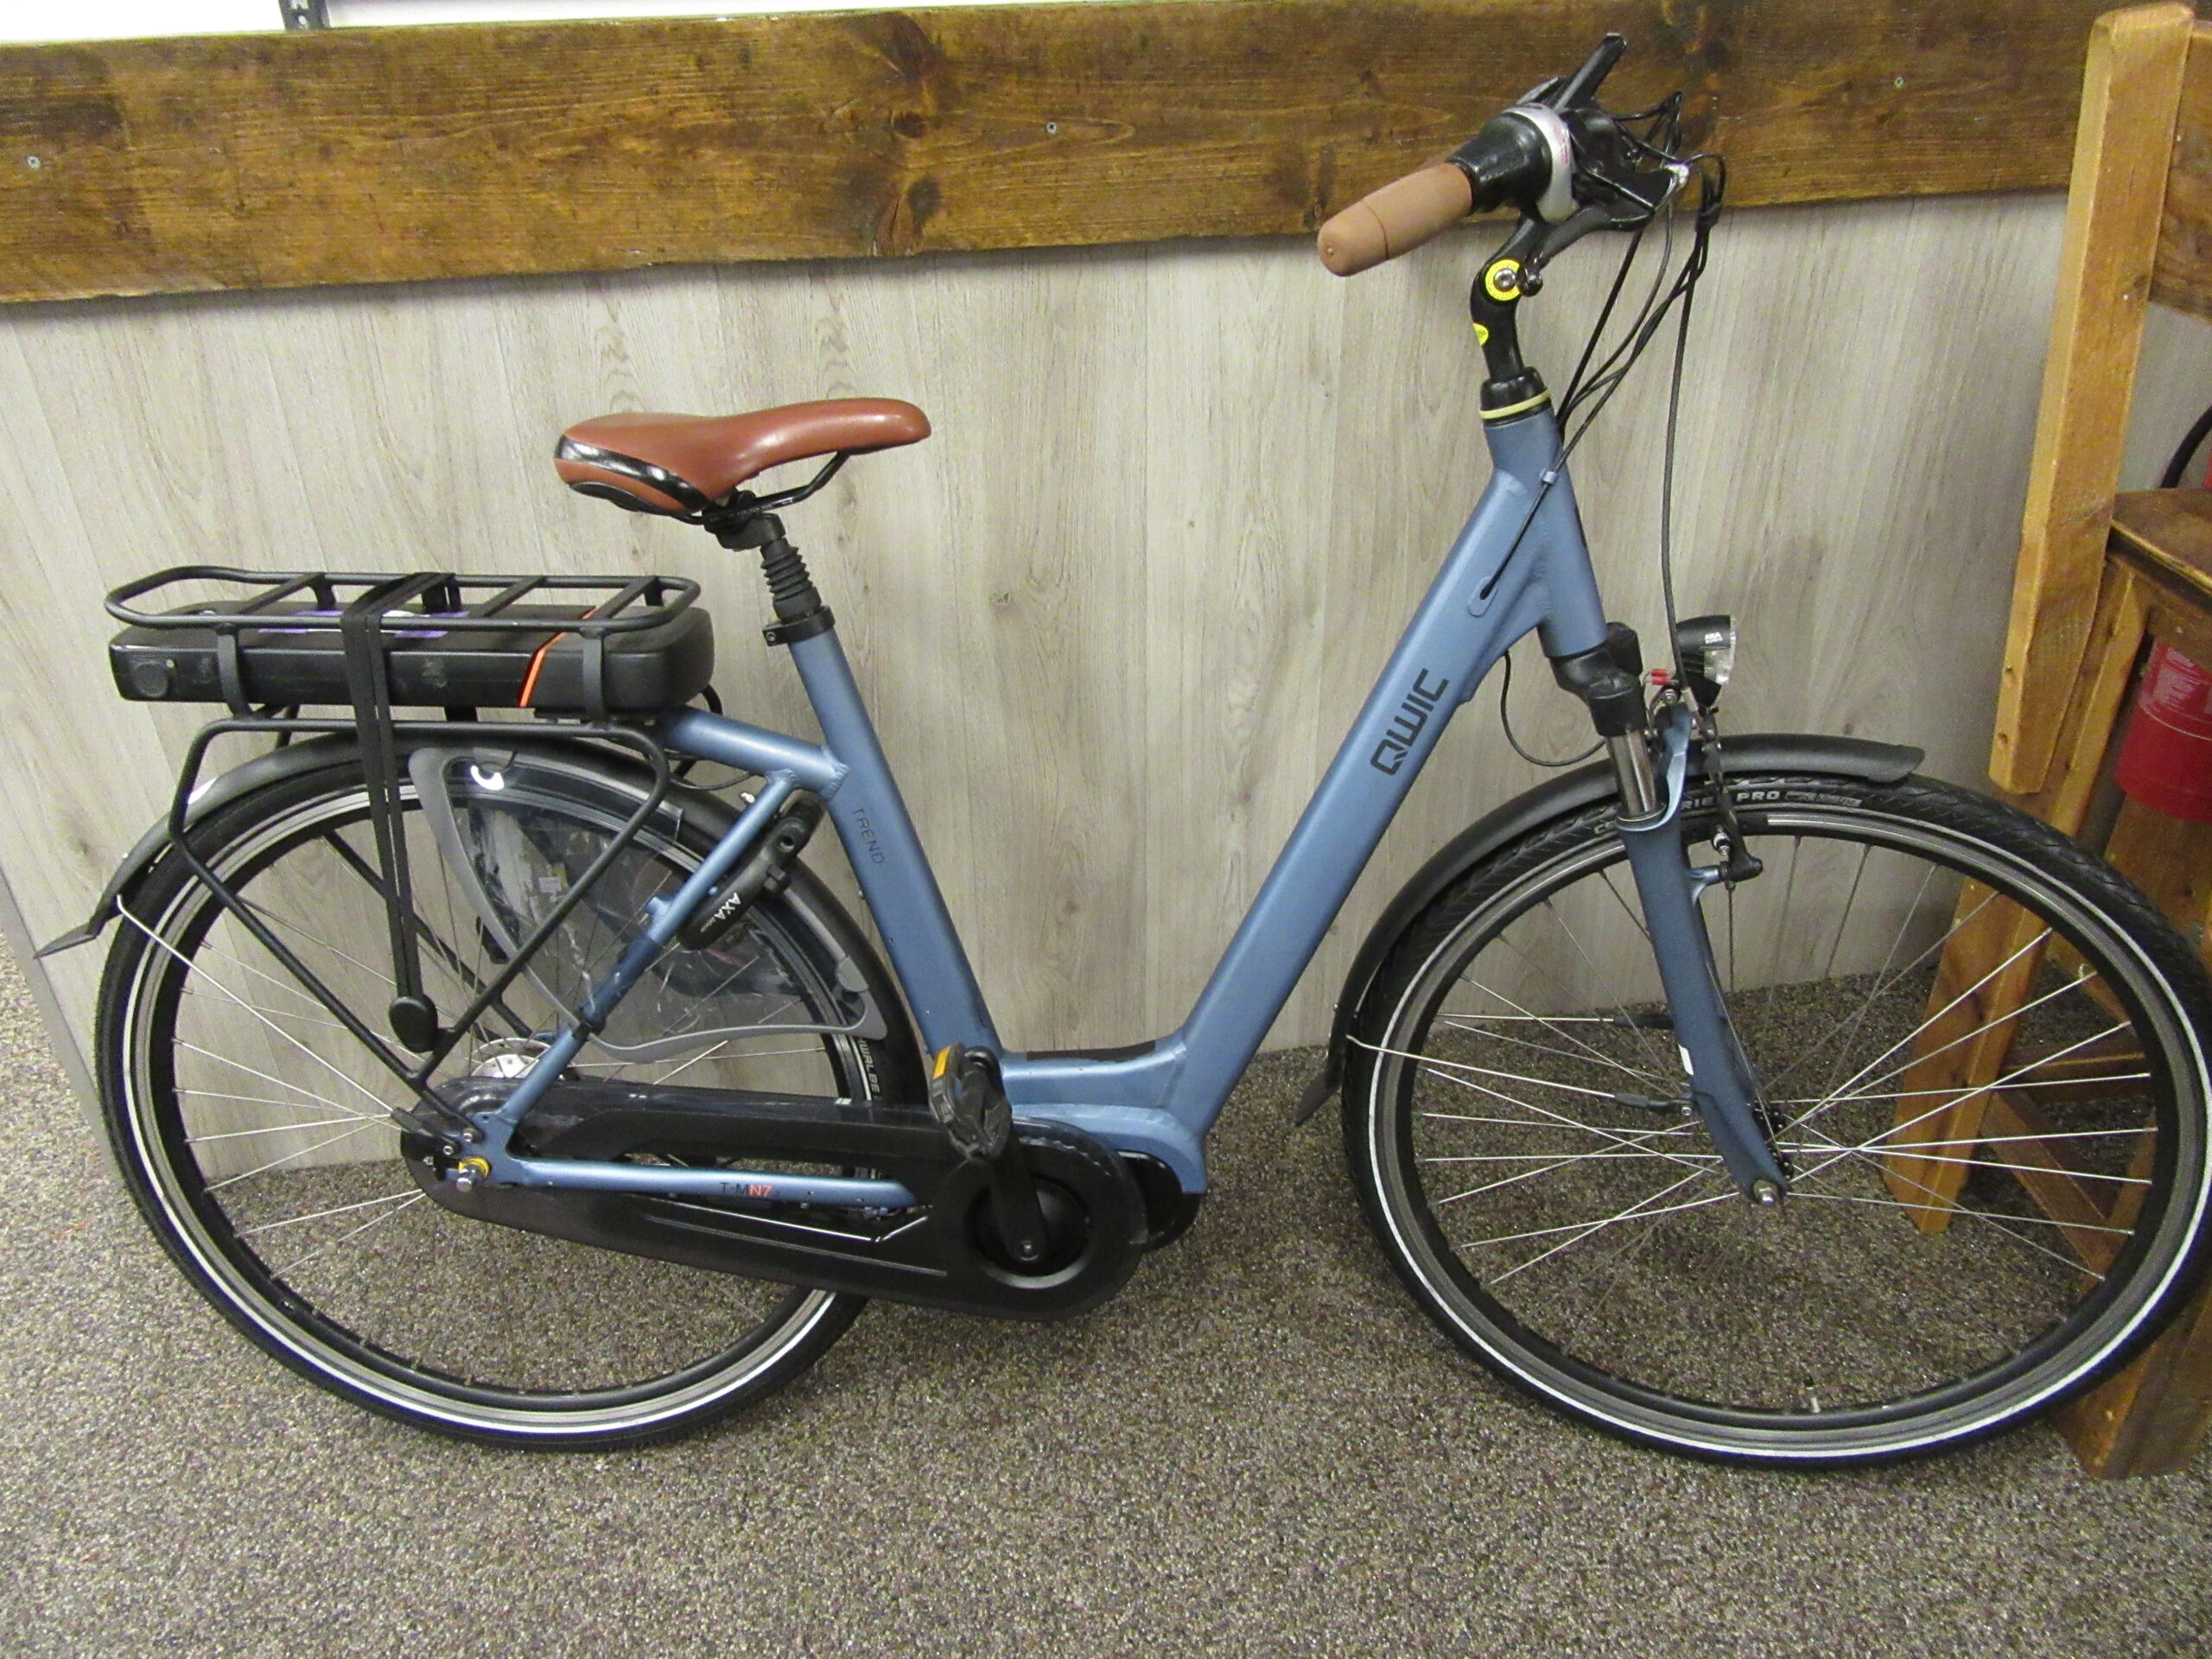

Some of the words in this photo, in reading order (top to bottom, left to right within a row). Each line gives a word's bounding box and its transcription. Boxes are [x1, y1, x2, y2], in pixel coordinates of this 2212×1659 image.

[1370, 668, 1449, 775] QWIC
[1737, 791, 1780, 802] PRO
[854, 806, 884, 864] TREND
[714, 892, 741, 920] AXA
